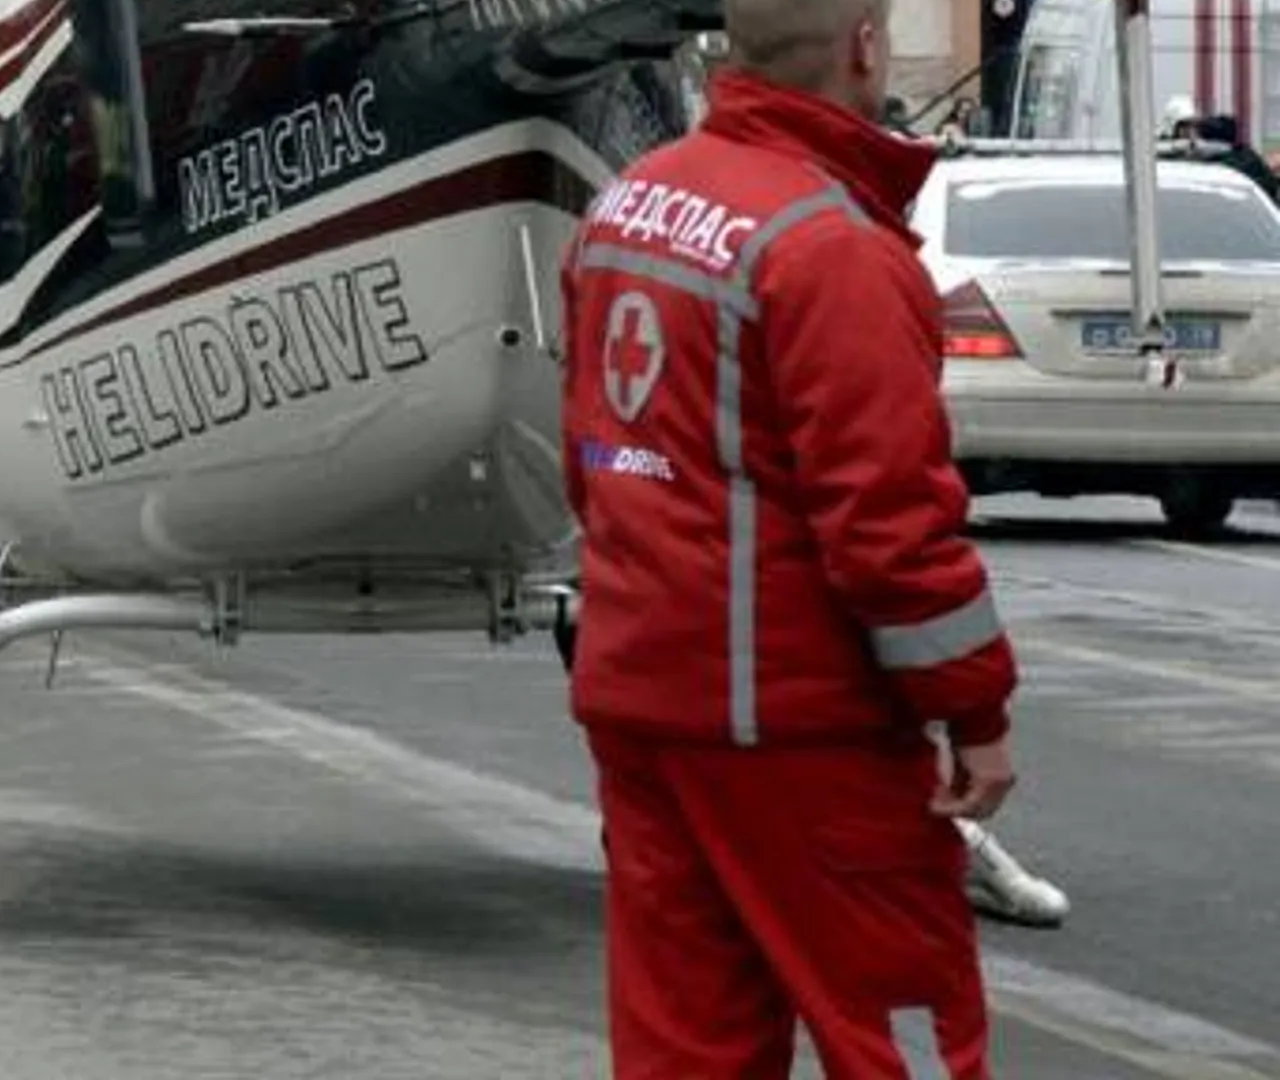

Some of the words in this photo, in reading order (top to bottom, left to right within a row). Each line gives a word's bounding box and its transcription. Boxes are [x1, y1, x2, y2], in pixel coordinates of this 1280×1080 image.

[178, 77, 387, 234] МЕДСПАС
[590, 180, 757, 262] МЕДСПАС
[42, 289, 428, 478] HELIDRIVE
